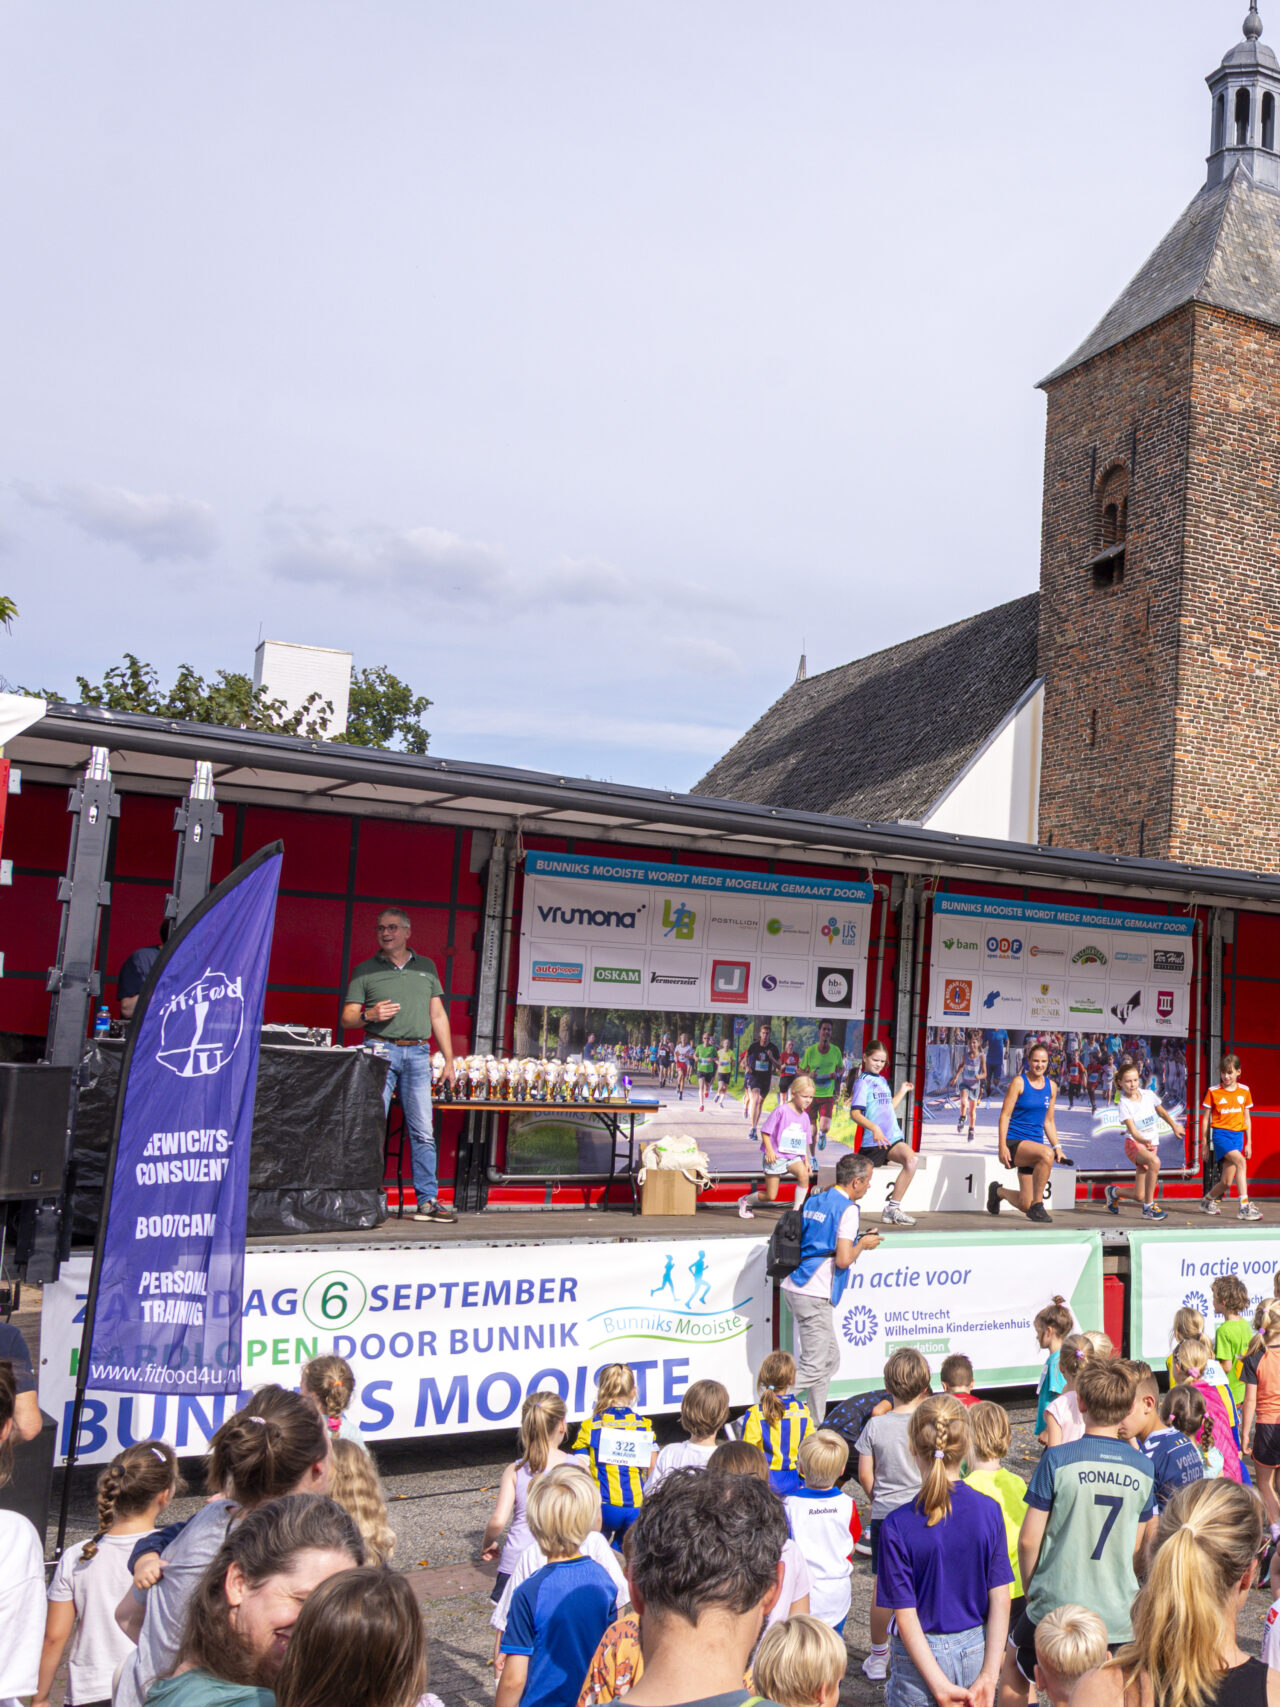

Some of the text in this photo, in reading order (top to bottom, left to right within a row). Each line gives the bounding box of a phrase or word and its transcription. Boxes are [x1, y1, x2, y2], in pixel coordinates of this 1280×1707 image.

[536, 860, 866, 899] BUNNIKS MOOISTE WORDT MEDE MOGELIJK GEMAAKT DOOR:
[537, 905, 636, 928] vrumona
[712, 917, 758, 926] POSTILLION
[941, 901, 1187, 932] BUNNIKS MOOISTE WORDT MEDE MOGELIJK GEMAAKT DOOR:
[957, 938, 978, 950] bam
[987, 938, 1021, 953] ODF
[535, 965, 580, 975] autohopper
[596, 969, 639, 981] OSKAM
[143, 1129, 233, 1156] GEWICHTS-
[965, 1174, 973, 1193] 1
[135, 1214, 217, 1239] BOOTCAM
[1181, 1257, 1278, 1276] In actie voor
[138, 1270, 207, 1295] PERSONL
[846, 1266, 972, 1289] n actie voor
[320, 1281, 348, 1320] 6
[369, 1277, 578, 1312] SEPTEMBER
[604, 1314, 741, 1336] Bunniks Mooiste
[884, 1309, 950, 1322] UMC Utrecht
[885, 1318, 1031, 1337] Wilhelmina Kinderziekenhuis
[333, 1332, 437, 1361] DOOR
[449, 1322, 579, 1355] BUNNIK
[888, 1343, 945, 1356] Fodation
[60, 1358, 690, 1456] BUNS MOOITE
[615, 1441, 636, 1452] 322
[1078, 1471, 1140, 1491] RONALDO
[1090, 1494, 1124, 1560] 7
